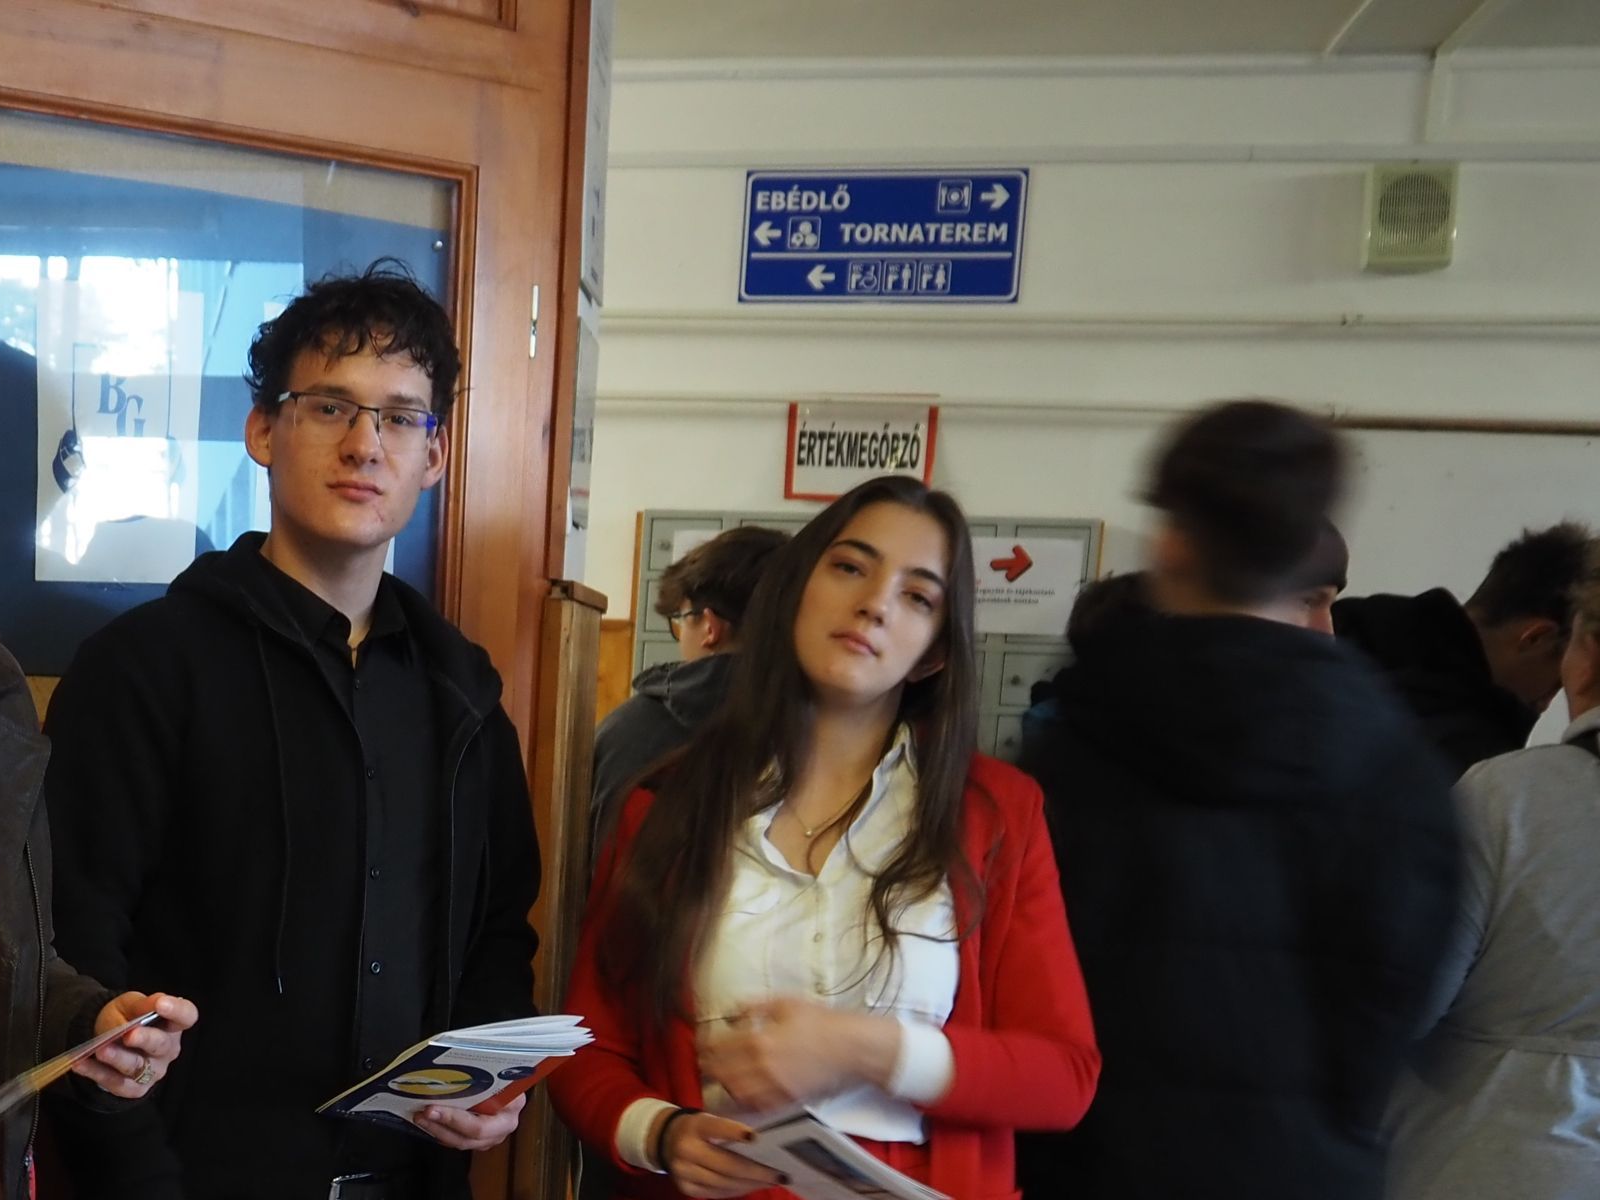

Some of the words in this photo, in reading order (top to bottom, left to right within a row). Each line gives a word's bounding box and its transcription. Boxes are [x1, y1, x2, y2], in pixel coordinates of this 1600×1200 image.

[755, 184, 851, 211] EBÉDLŐ
[840, 222, 1008, 244] TORNATEREM
[797, 421, 921, 469] ÉRTÉKMEGŐRZŐ
